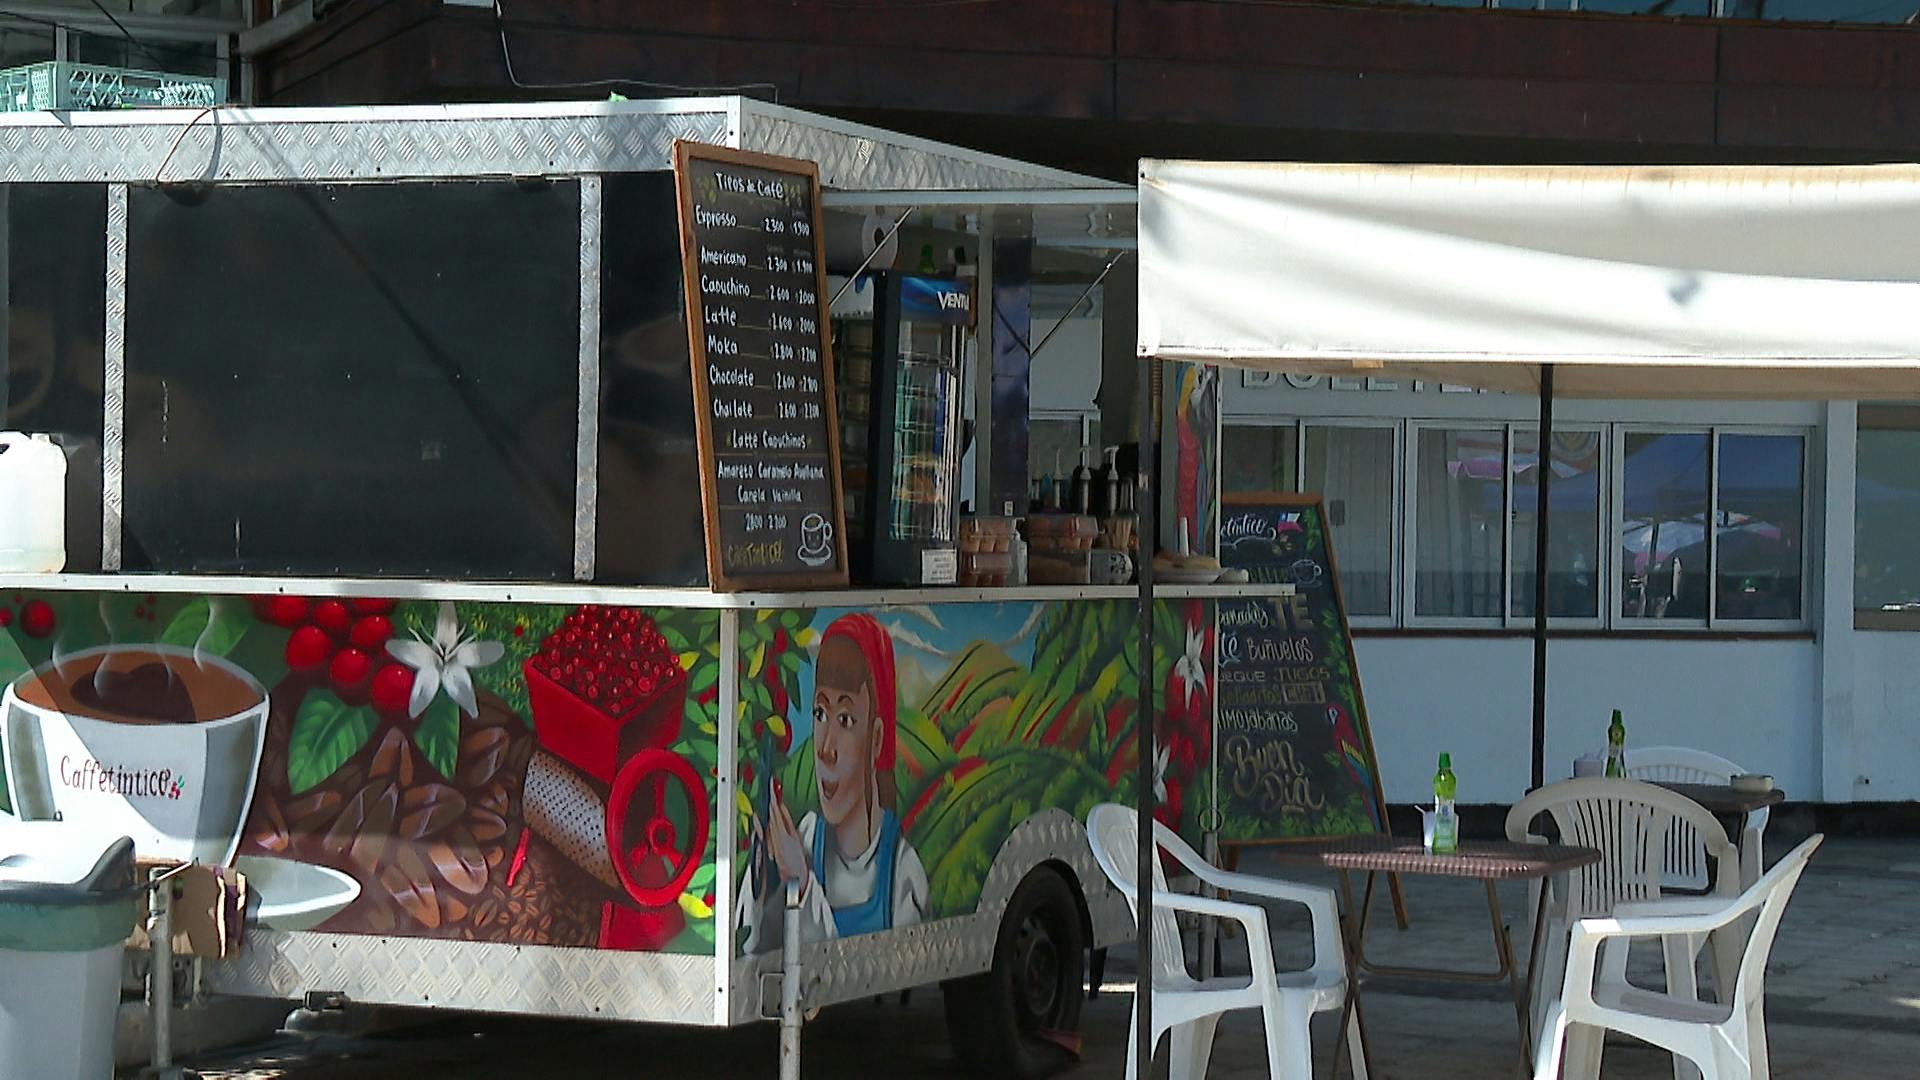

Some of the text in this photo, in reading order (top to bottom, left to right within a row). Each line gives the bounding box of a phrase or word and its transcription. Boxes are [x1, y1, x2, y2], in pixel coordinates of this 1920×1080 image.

[695, 204, 737, 230] Expresso
[701, 245, 747, 267] Americano
[705, 304, 737, 327] Latte
[707, 333, 739, 356] Moka
[709, 362, 755, 387] Chocolate
[732, 428, 758, 449] Latte
